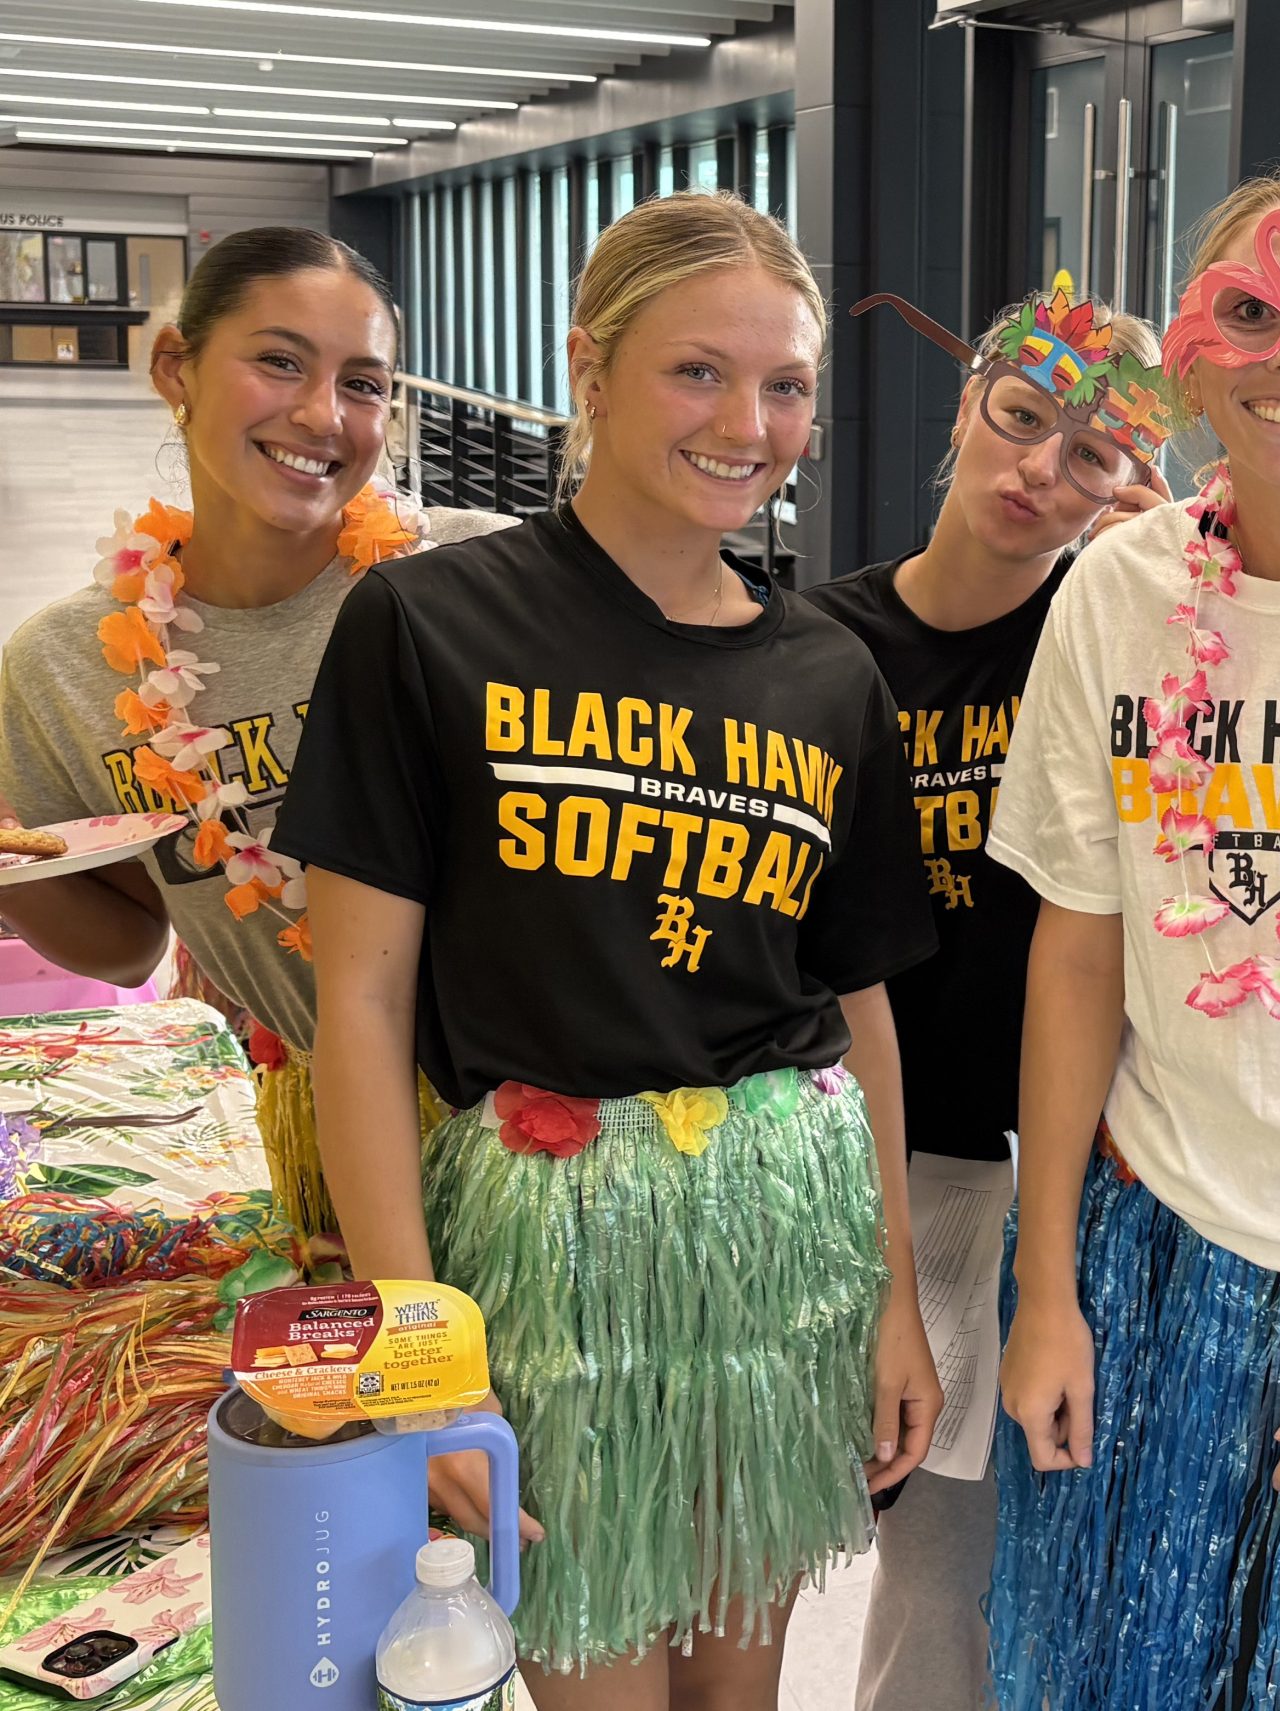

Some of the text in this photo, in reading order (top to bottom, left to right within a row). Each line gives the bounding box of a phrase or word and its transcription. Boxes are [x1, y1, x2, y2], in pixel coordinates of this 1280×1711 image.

[19, 214, 64, 227] POLICE
[485, 681, 697, 777] BLACK
[723, 717, 844, 831] HAWK
[909, 765, 987, 789] RAVES
[640, 776, 770, 818] BRAVES
[305, 1308, 368, 1319] SARGENTO
[394, 1301, 438, 1315] WHEAT
[395, 1309, 438, 1325] THINS
[288, 1317, 375, 1332] Balanced
[398, 1322, 437, 1332] original
[288, 1329, 355, 1341] Breaks
[388, 1331, 448, 1345] SOME THINGS
[398, 1339, 439, 1350] ARE JUST
[393, 1346, 443, 1359] better
[384, 1354, 454, 1370] together
[255, 1365, 353, 1380] Cheese & Crackers
[390, 1383, 400, 1391] NET
